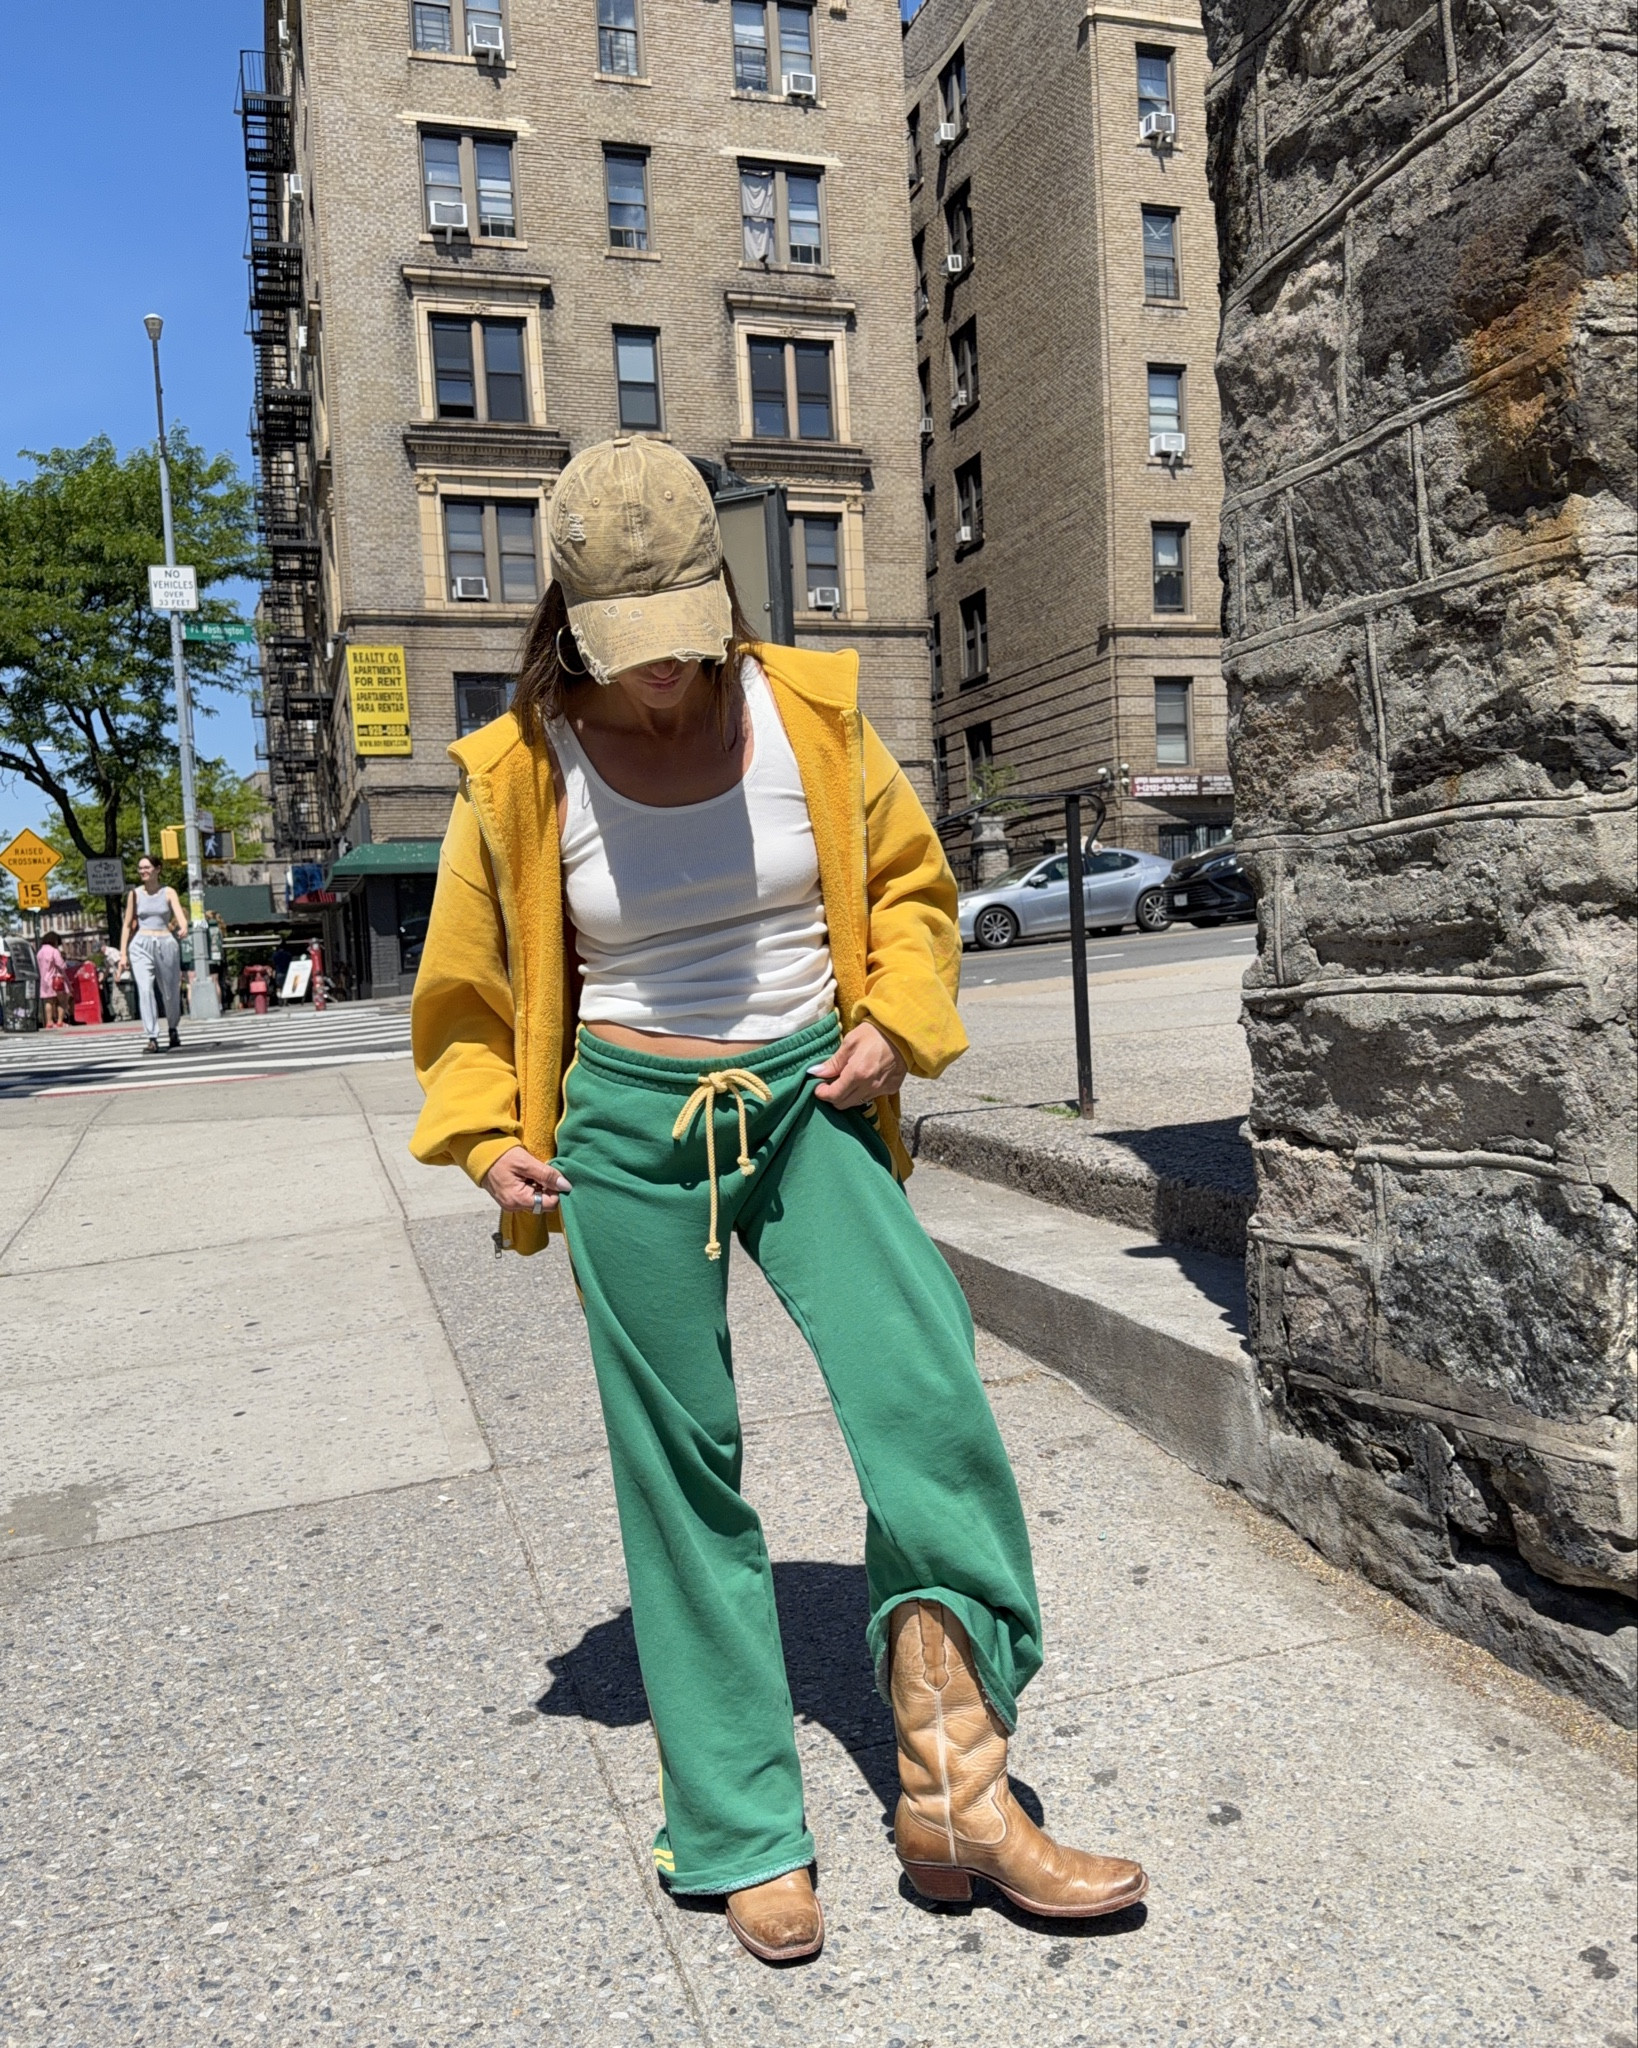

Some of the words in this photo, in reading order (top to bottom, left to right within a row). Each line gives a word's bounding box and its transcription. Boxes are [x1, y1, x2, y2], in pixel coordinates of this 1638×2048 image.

[164, 569, 180, 578] NO
[153, 581, 194, 589] VEHICLES
[202, 624, 245, 637] Washngton
[352, 652, 385, 663] REALTY
[354, 666, 402, 675] APARTMENTS
[355, 677, 374, 686] FOR
[377, 677, 402, 686] RENT
[356, 692, 404, 701] APARTAMENTOS
[357, 703, 375, 712] PARA
[378, 703, 405, 712] RENTAR
[15, 847, 44, 856] RAISED
[8, 857, 52, 866] CROSSWALK
[24, 884, 42, 897] 15
